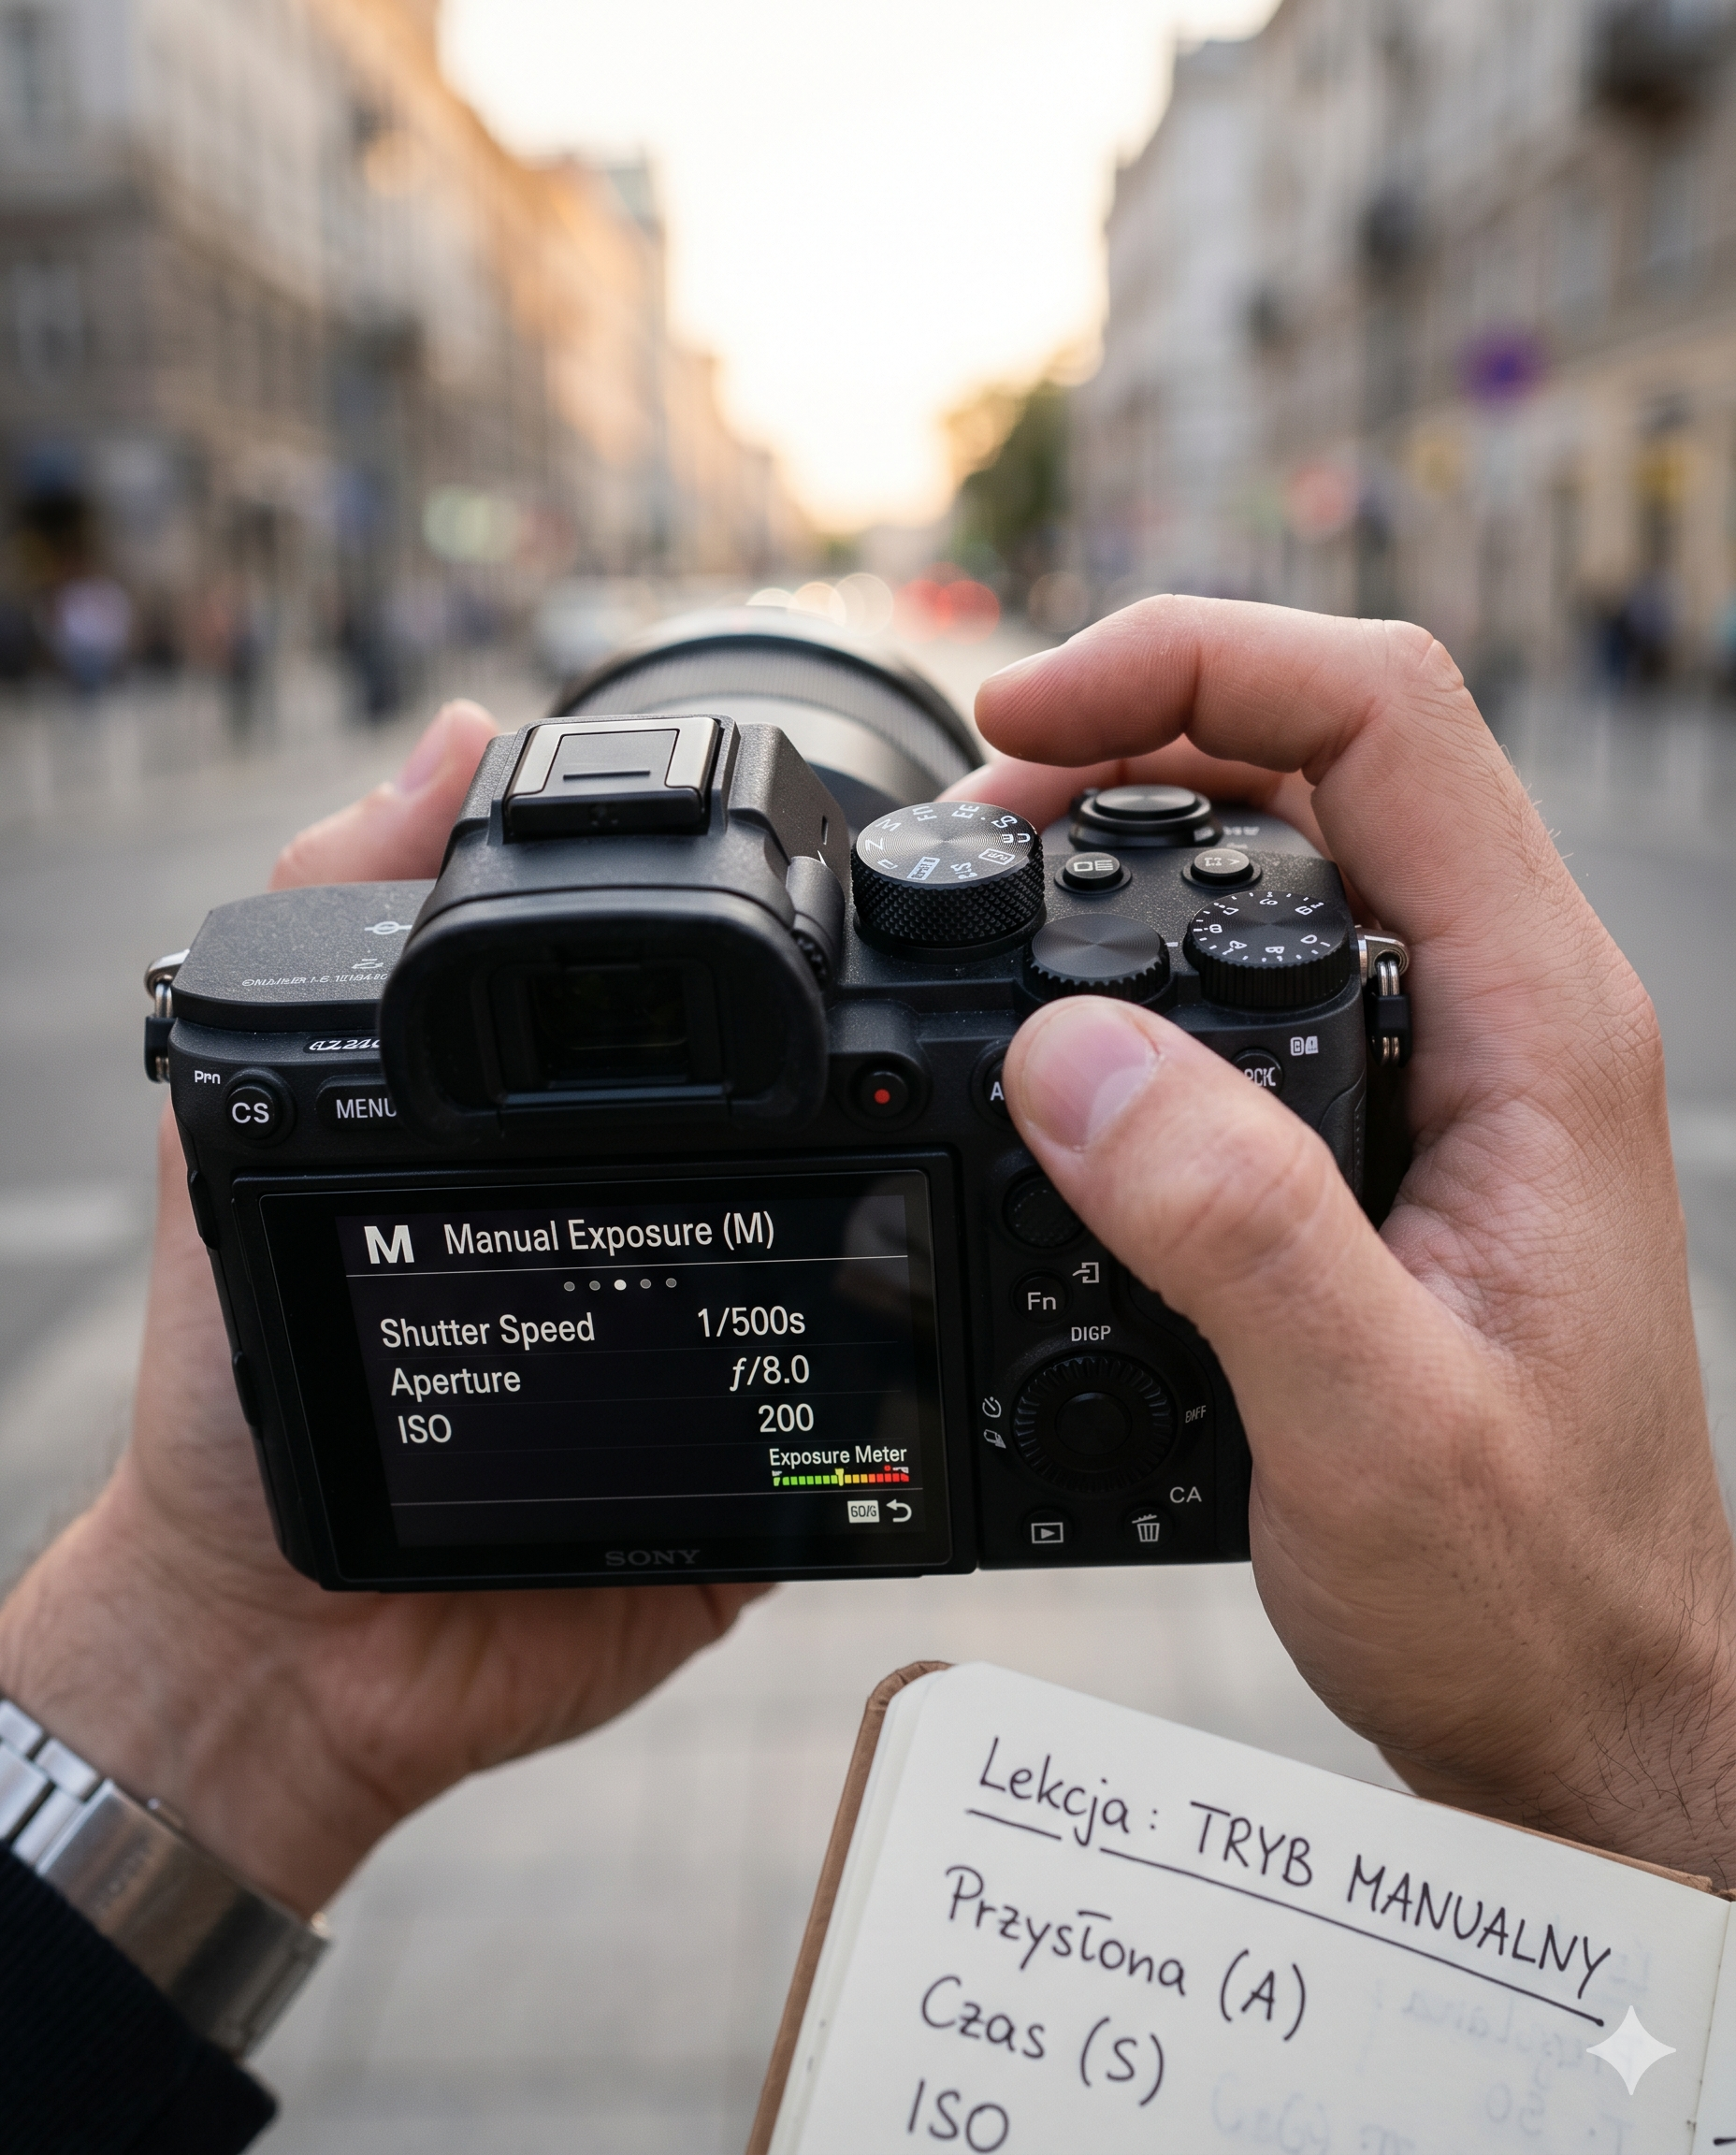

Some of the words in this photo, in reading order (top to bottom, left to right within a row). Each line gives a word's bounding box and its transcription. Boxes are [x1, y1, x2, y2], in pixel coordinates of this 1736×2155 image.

[232, 1102, 270, 1123] CS
[336, 1097, 398, 1119] MENU
[365, 1224, 414, 1264] M
[444, 1220, 559, 1255] Manual
[568, 1217, 713, 1256] Exposure
[723, 1210, 774, 1250] (M)
[1027, 1292, 1057, 1310] Fn
[380, 1316, 490, 1348] Shutter
[500, 1312, 595, 1351] Speed
[698, 1305, 805, 1338] 1/500s
[391, 1367, 521, 1403] Aperture
[398, 1413, 452, 1444] ISO
[758, 1403, 814, 1434] 200
[769, 1448, 850, 1469] Exposure
[855, 1444, 907, 1463] Meter
[1169, 1486, 1203, 1503] CA
[604, 1549, 701, 1567] SONY
[1190, 1801, 1312, 1887] TRYB
[1347, 1854, 1612, 2000] MANUALNY
[1219, 1949, 1306, 2041] (A)
[921, 1975, 1046, 2060] Czas
[1080, 2017, 1165, 2106] (S)
[907, 2079, 1010, 2155] ISO
